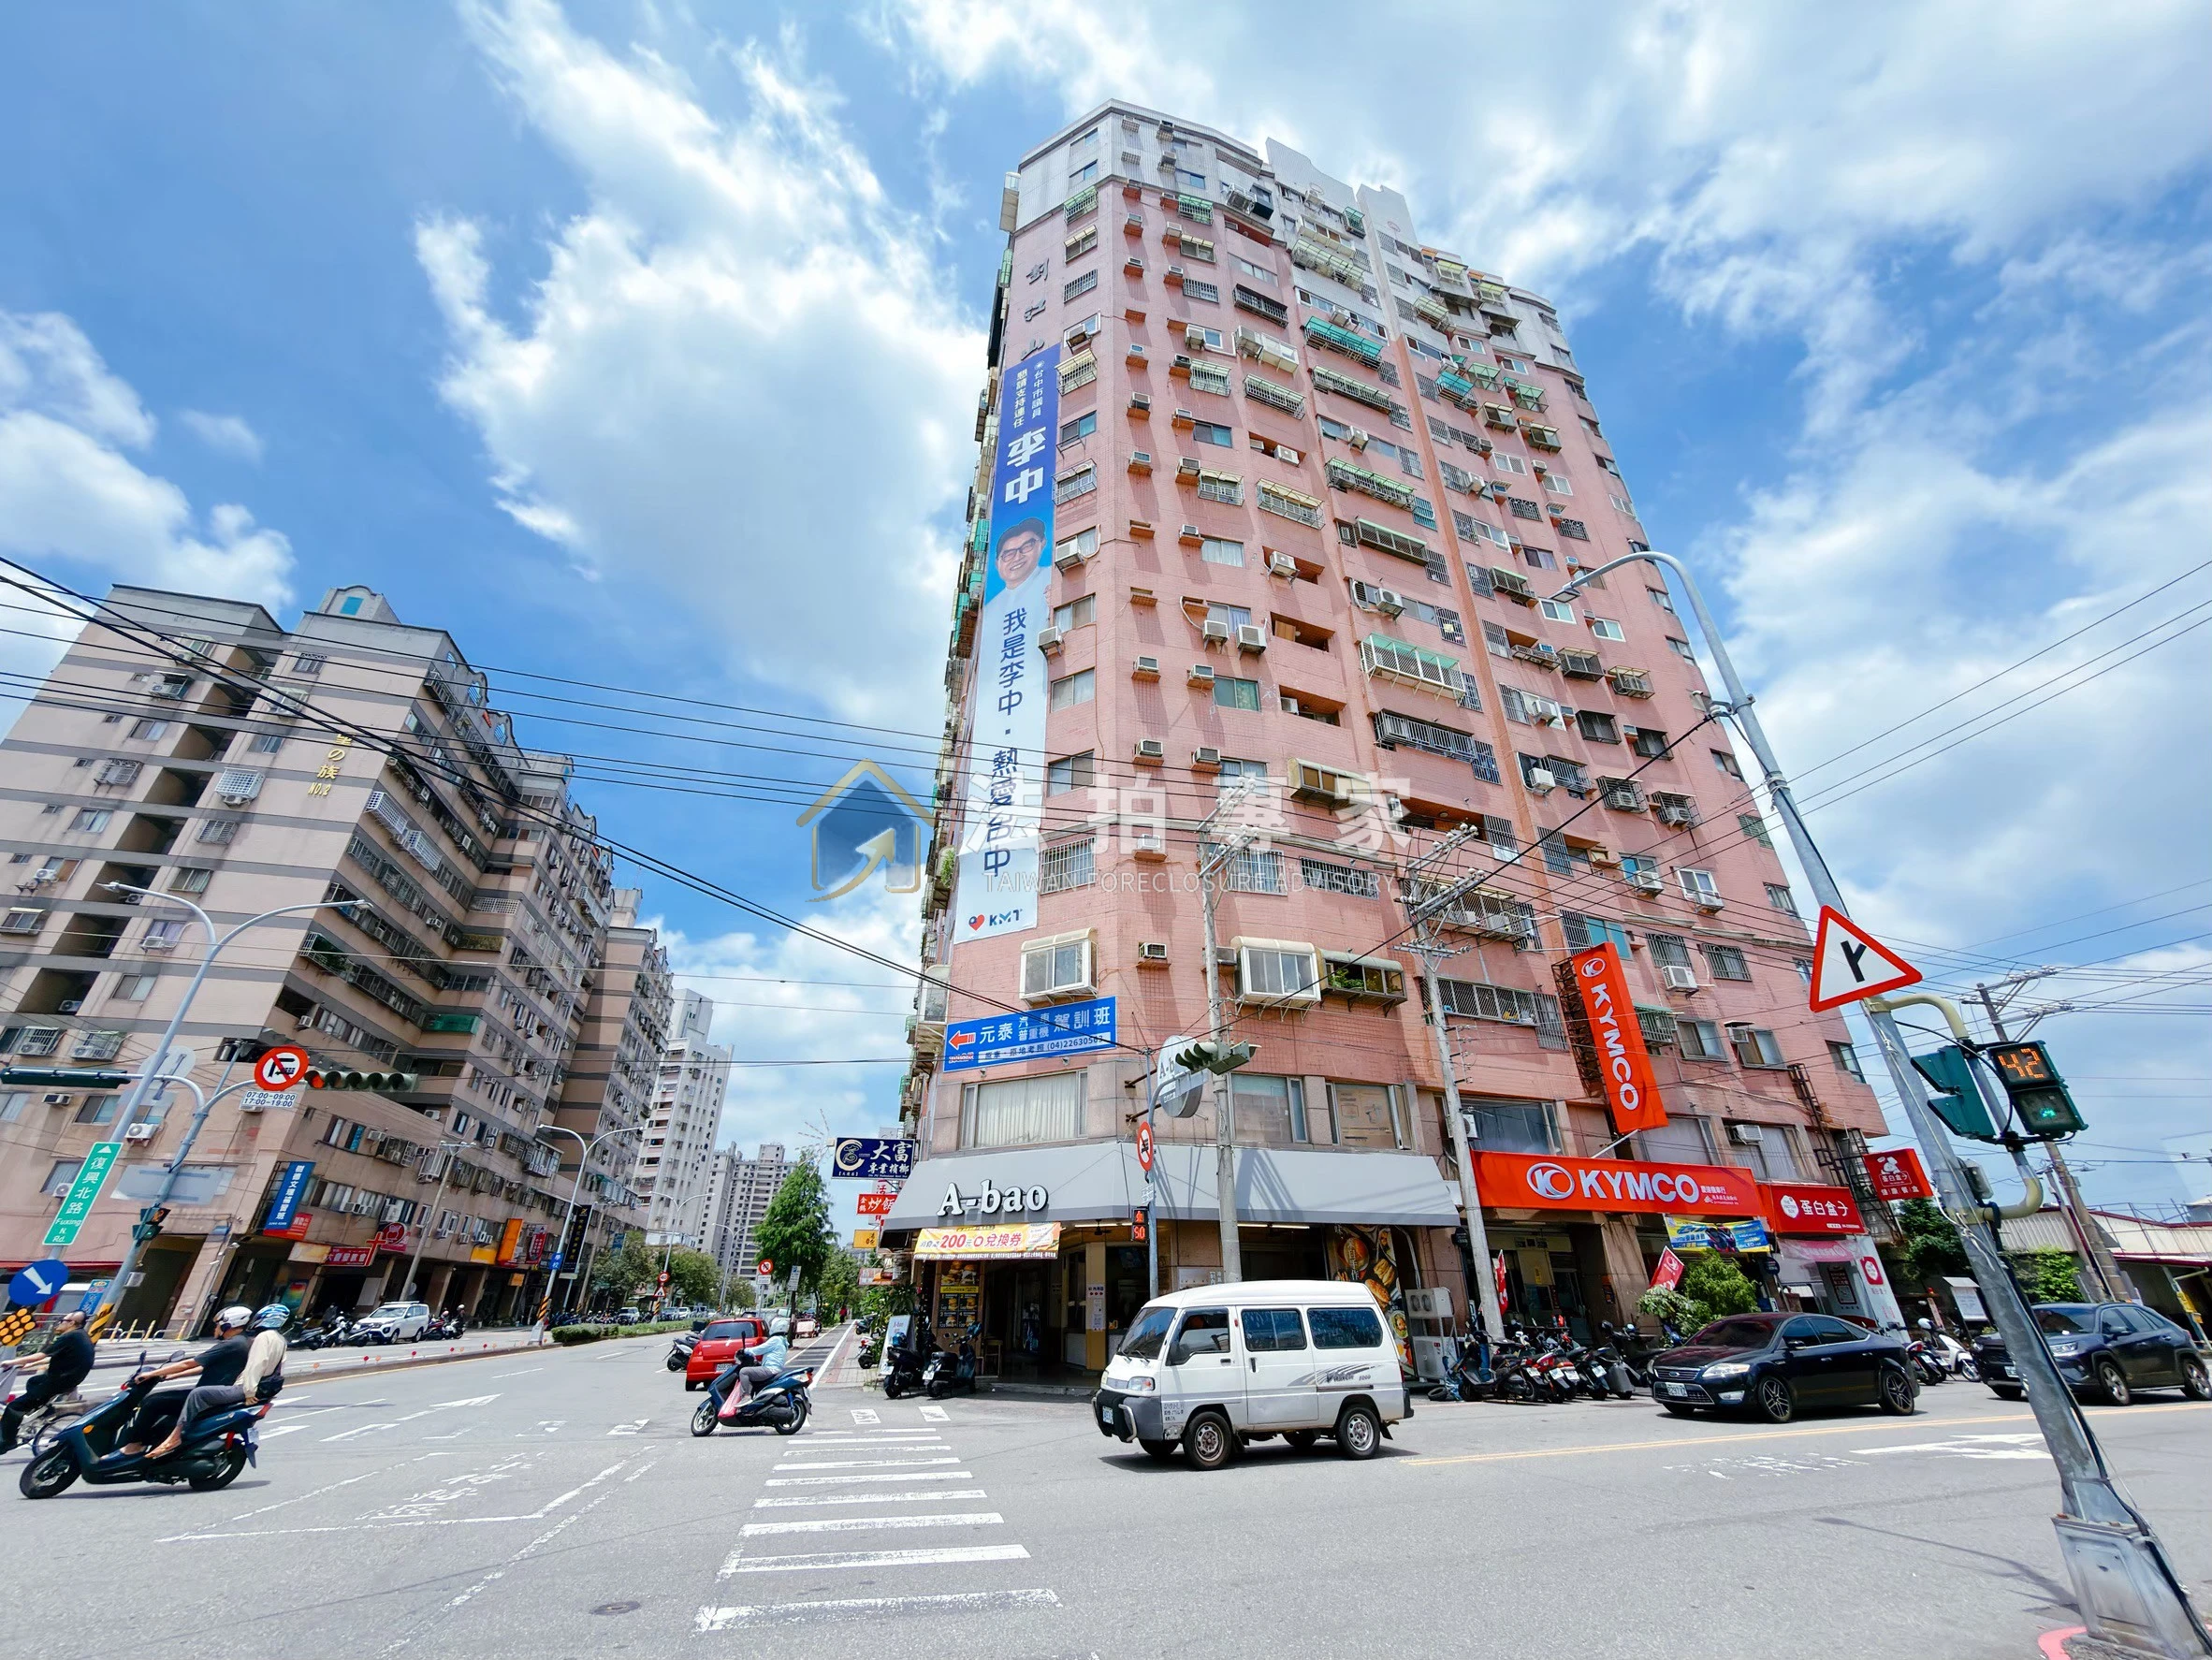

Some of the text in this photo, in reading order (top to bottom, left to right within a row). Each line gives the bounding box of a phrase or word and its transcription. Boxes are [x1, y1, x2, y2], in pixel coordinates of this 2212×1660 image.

[1031, 370, 1043, 419] 台中市議員
[1005, 427, 1046, 505] 李中
[989, 910, 1019, 926] KMT
[980, 1022, 1013, 1044] 元泰
[1054, 1006, 1111, 1033] 駕訓班
[1018, 1026, 1050, 1041] 普重機
[1591, 983, 1639, 1111] KYMCO
[1998, 1048, 2045, 1079] 42
[244, 1098, 293, 1107] 17:00-19:00
[246, 1091, 296, 1101] 07:00-09:00
[870, 1141, 912, 1162] 大富
[867, 1162, 910, 1175] 專業檳榔
[65, 1157, 108, 1214] 復興北路
[937, 1178, 1049, 1216] A-bao
[1579, 1169, 1700, 1204] KYMCO
[1800, 1200, 1849, 1217] 蛋白盒子
[55, 1217, 82, 1227] Fuxing
